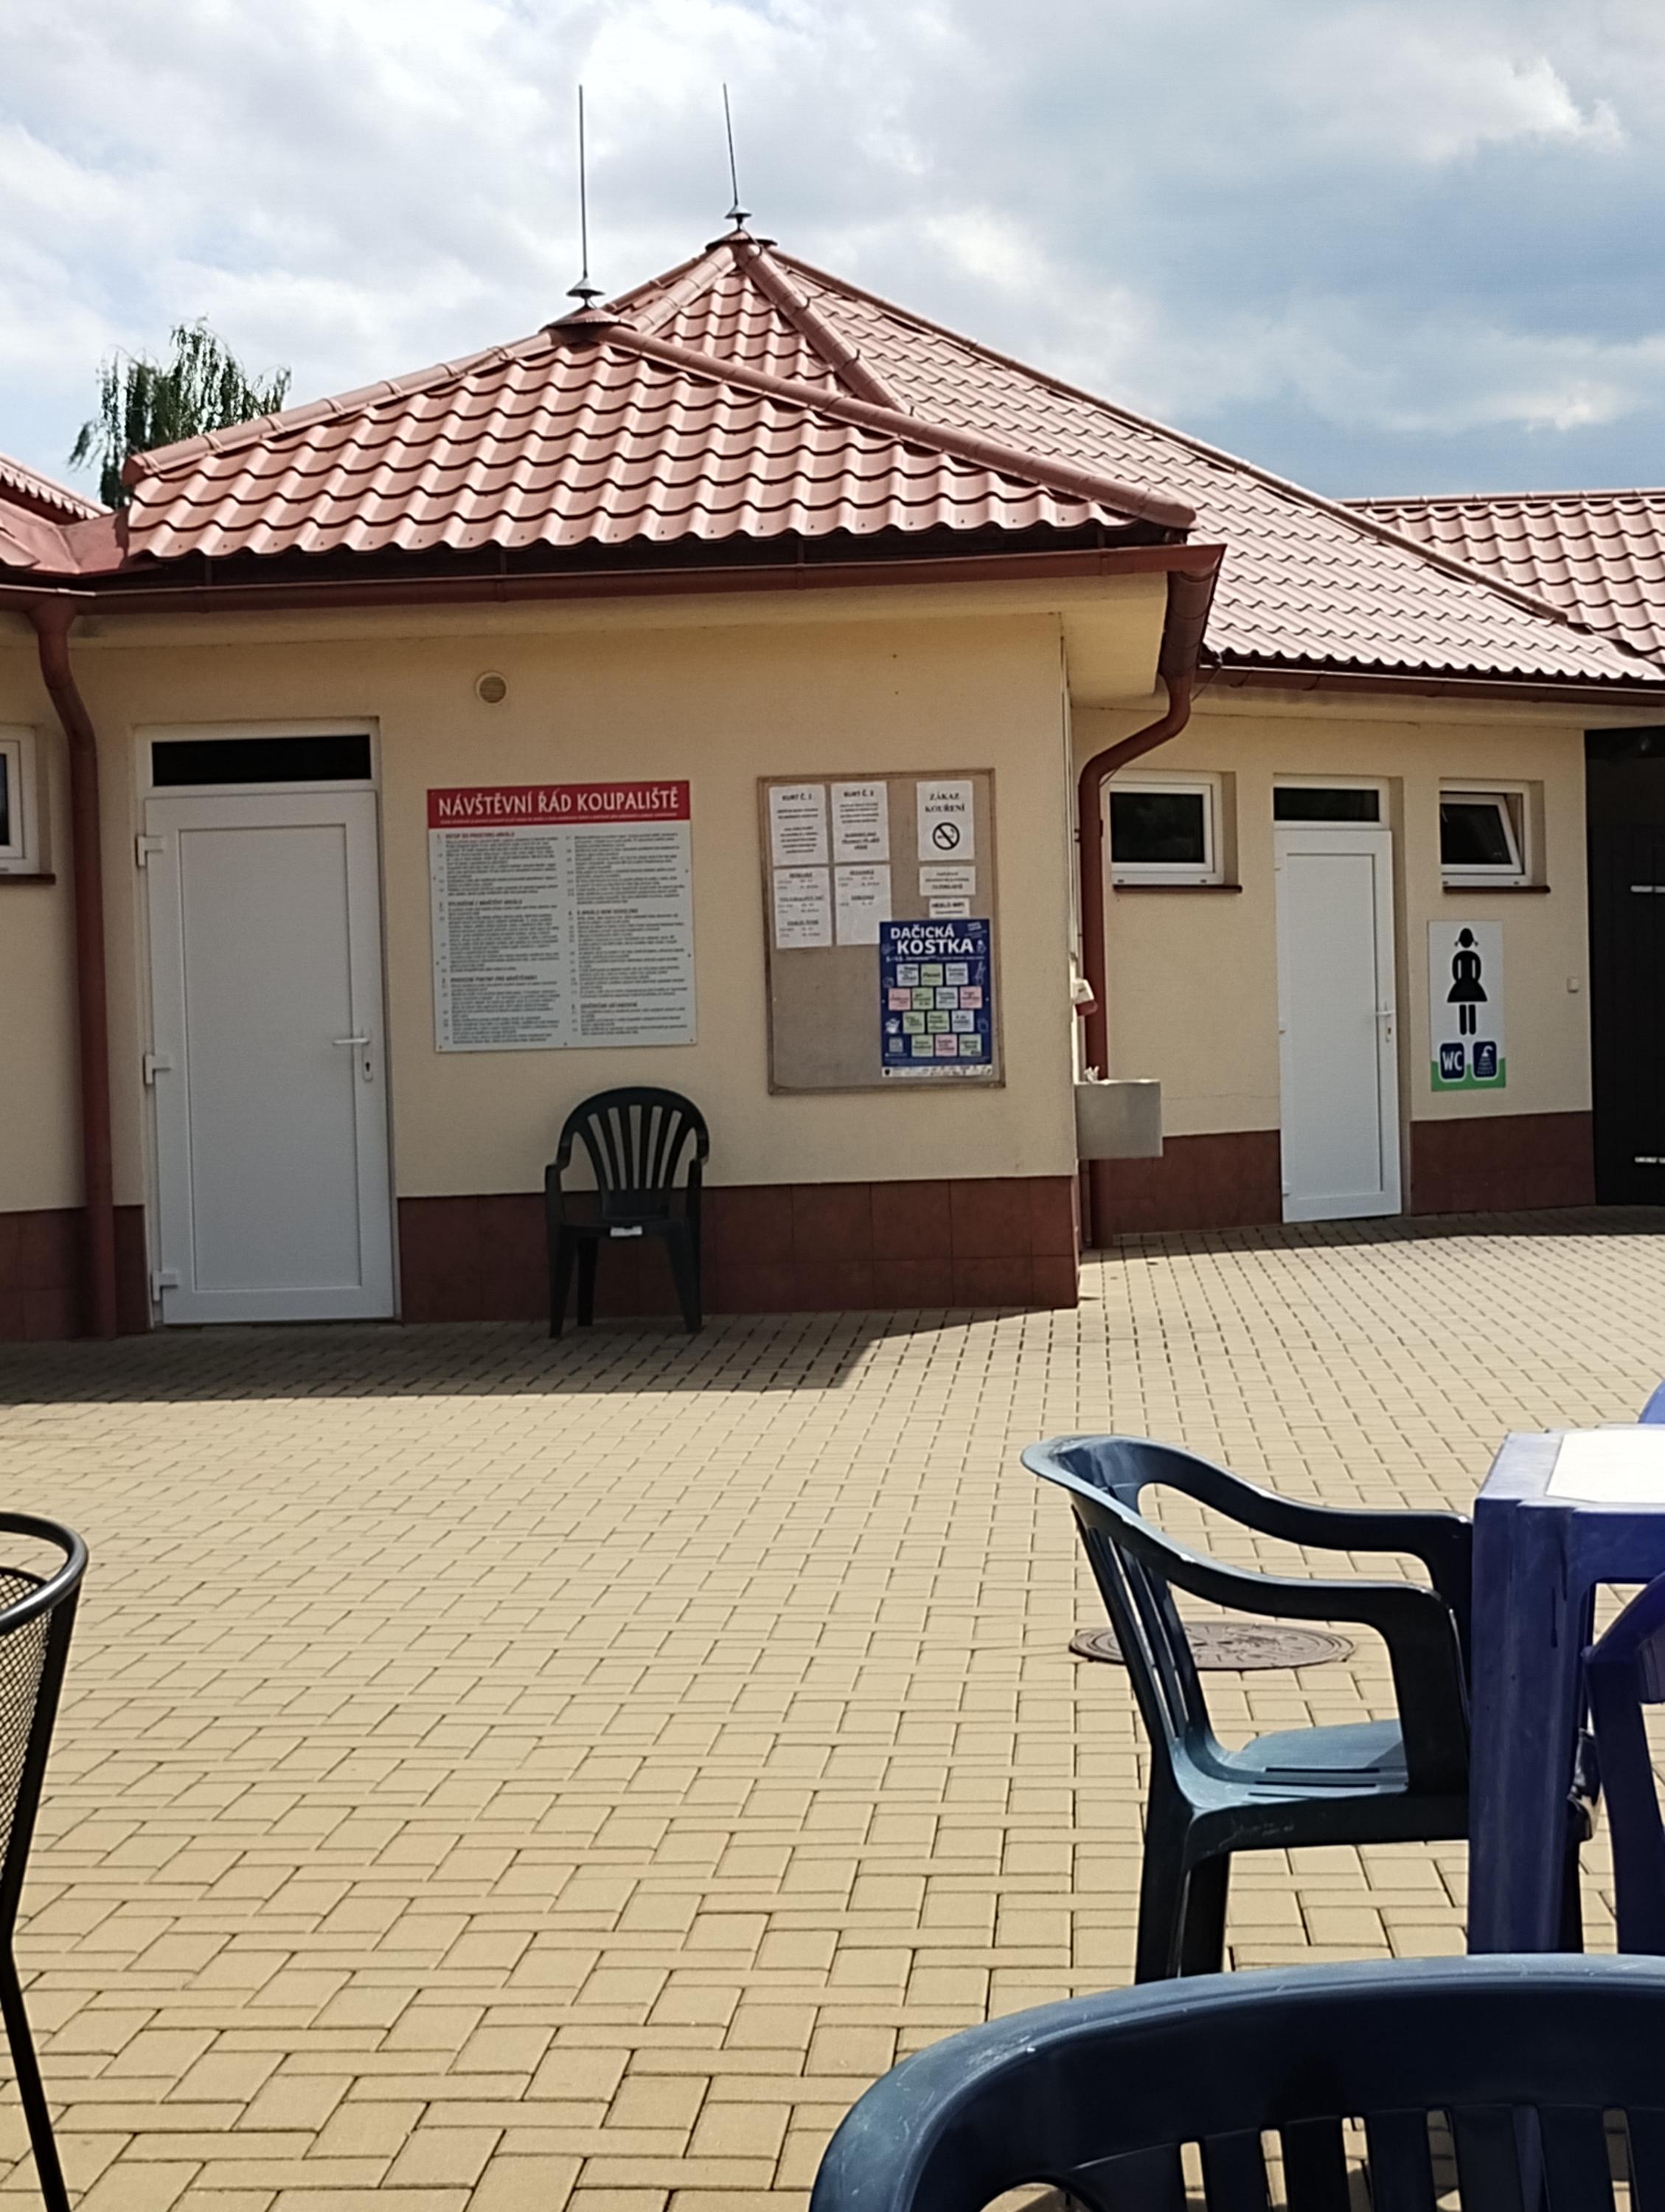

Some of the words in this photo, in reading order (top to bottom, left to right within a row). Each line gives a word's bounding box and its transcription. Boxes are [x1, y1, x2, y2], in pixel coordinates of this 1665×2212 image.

[438, 791, 533, 815] NÁVŠTĚVNÍ
[538, 786, 572, 813] ŘÁD
[577, 786, 679, 812] KOUPALIŠTĚ
[930, 792, 960, 801] ZÁKAZ
[925, 803, 965, 813] KOUŘENÍ
[890, 923, 955, 940] DAČICKÁ
[897, 939, 974, 955] KOSTKA
[1442, 1050, 1464, 1071] WC
